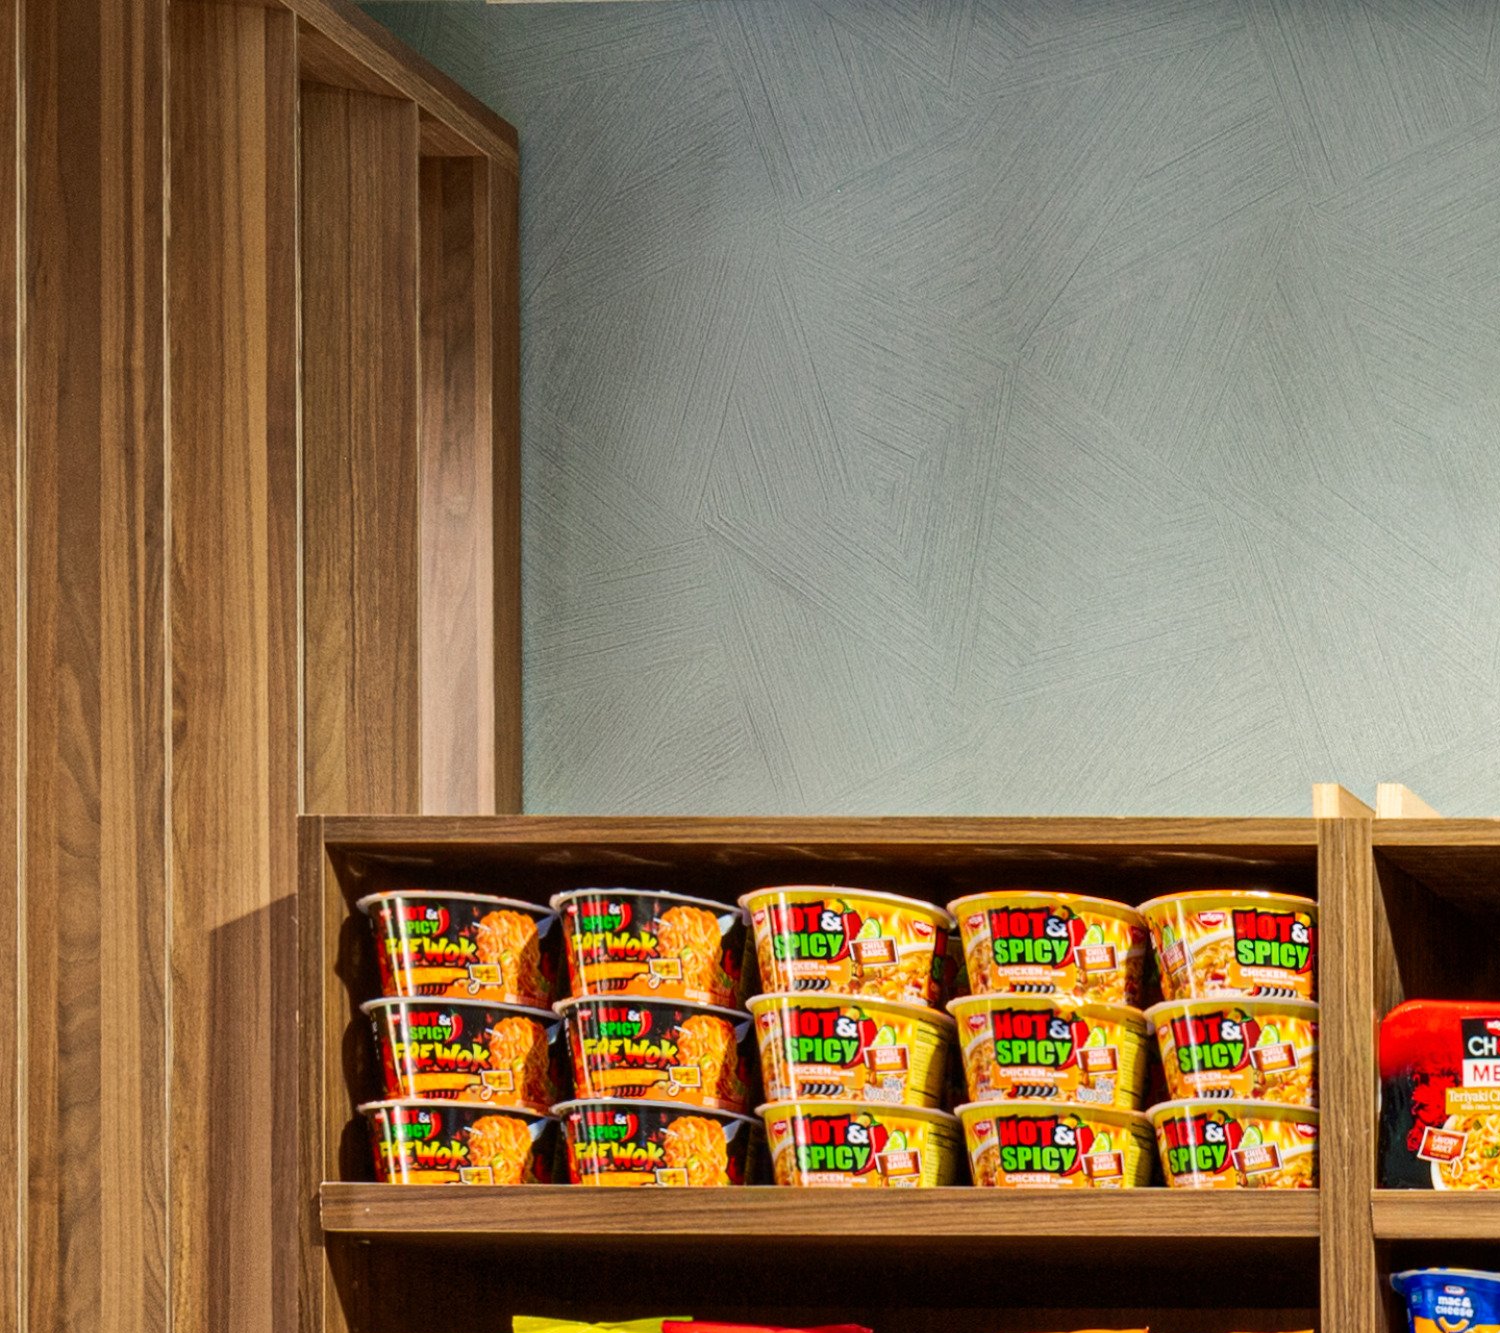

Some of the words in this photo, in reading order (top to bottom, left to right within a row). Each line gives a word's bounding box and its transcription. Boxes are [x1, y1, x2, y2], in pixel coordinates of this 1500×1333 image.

[991, 910, 1047, 939] HOT
[1046, 919, 1068, 937] &
[1234, 910, 1295, 942] HOT
[1292, 923, 1309, 943] &
[994, 938, 1069, 964] SPICY
[1236, 940, 1309, 969] SPICY
[998, 966, 1043, 977] CHICKEN
[1240, 969, 1287, 979] CHICKEN
[995, 1012, 1050, 1039] HOT
[1050, 1020, 1071, 1039] &
[997, 1040, 1072, 1065] SPICY
[1449, 1091, 1488, 1104] Teriyaki
